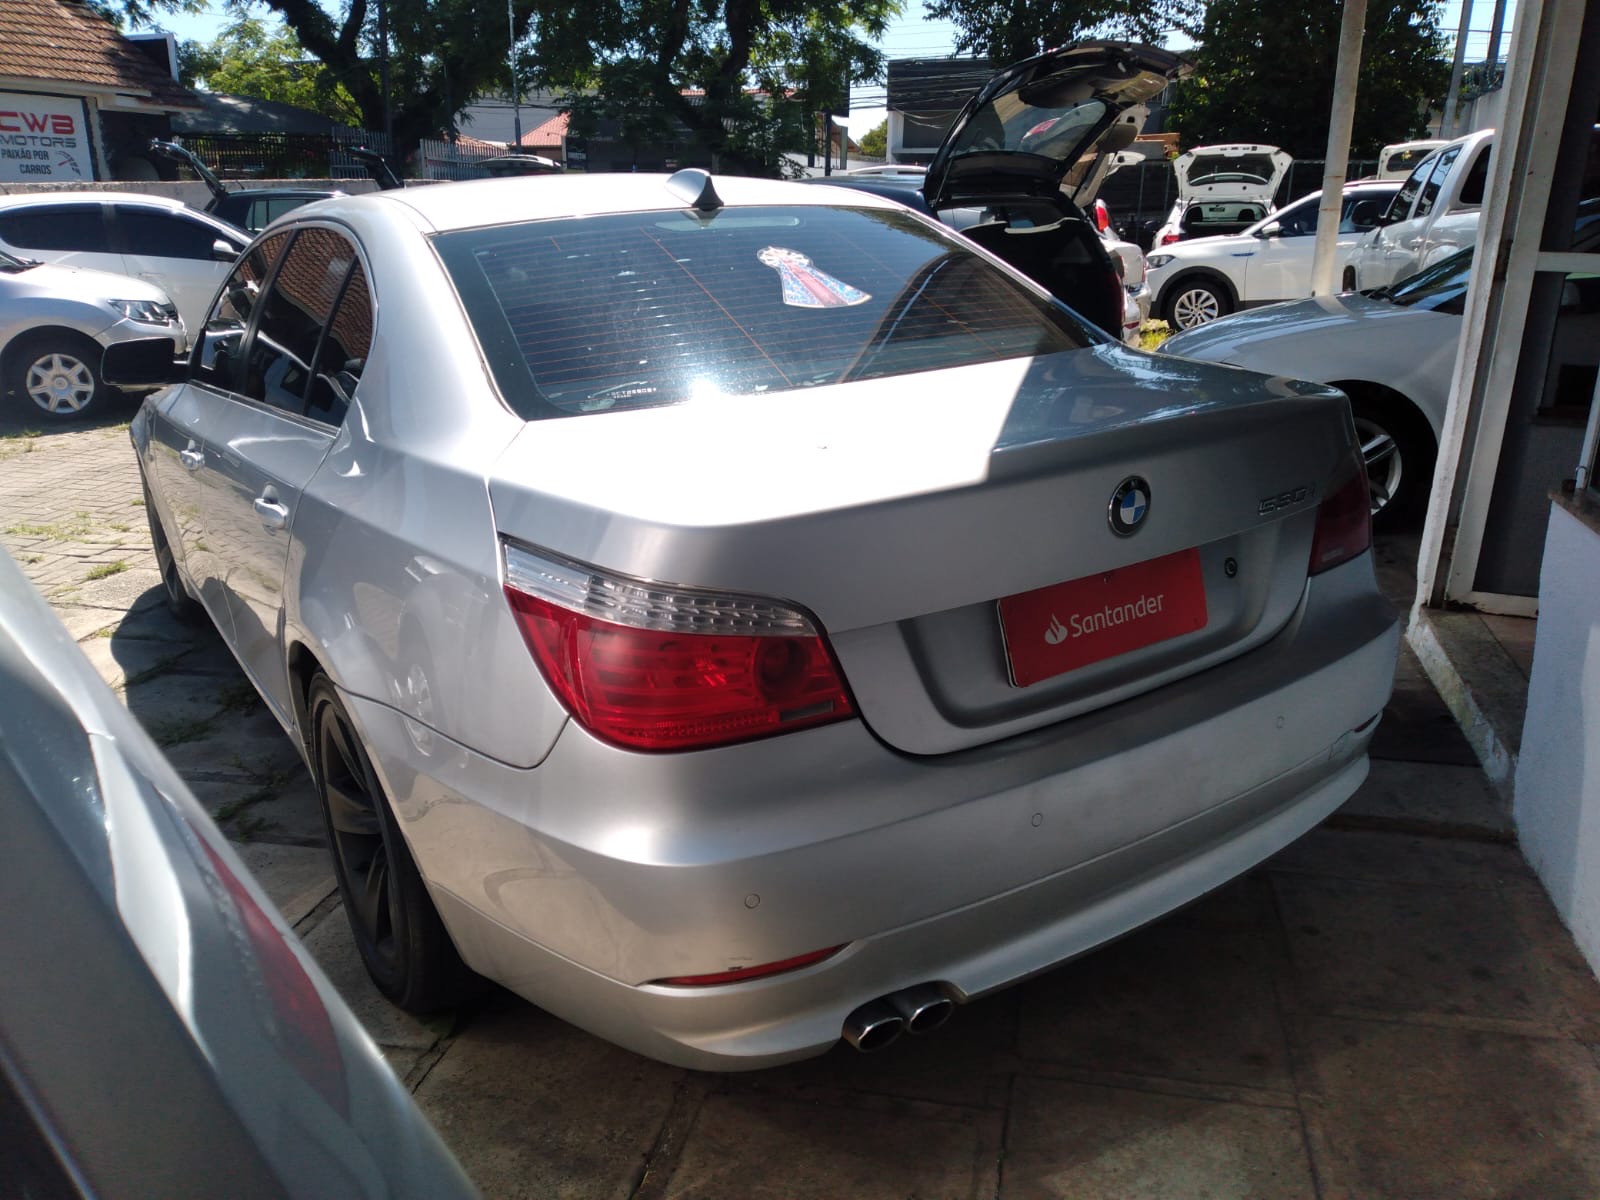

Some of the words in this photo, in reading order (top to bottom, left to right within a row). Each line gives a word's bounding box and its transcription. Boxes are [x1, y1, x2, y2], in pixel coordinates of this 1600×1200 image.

[0, 111, 75, 135] CWB
[0, 135, 77, 148] MOTORS
[33, 150, 50, 160] POR
[19, 164, 52, 175] CARROS
[1070, 594, 1164, 638] Santander
